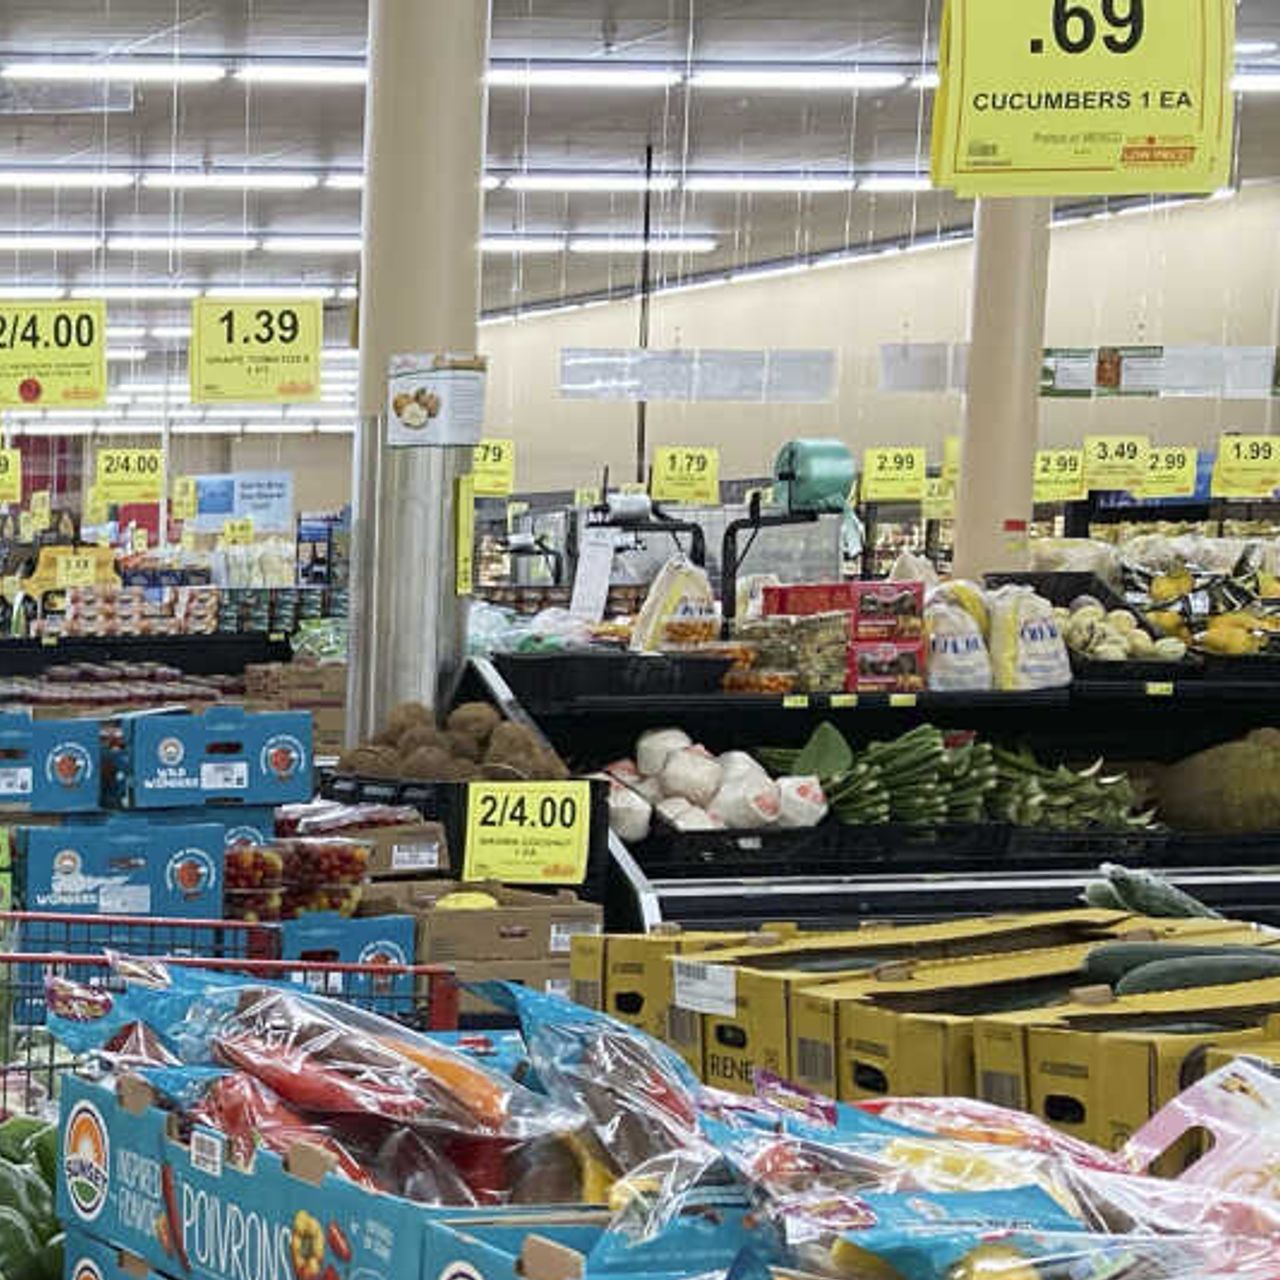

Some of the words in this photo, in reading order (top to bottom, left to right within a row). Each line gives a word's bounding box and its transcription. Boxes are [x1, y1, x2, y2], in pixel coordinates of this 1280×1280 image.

[1029, 0, 1145, 54] .69
[973, 91, 1132, 111] CUCUMBERS
[1140, 91, 1151, 109] 1
[1159, 90, 1193, 109] EA
[218, 309, 299, 344] 1.39
[1097, 442, 1138, 460] 3.49
[1233, 443, 1273, 460] 1.99
[104, 455, 159, 474] 2/4.00
[668, 454, 708, 472] 1.79
[877, 454, 915, 471] 2.99
[1040, 456, 1078, 473] 2.99
[1150, 453, 1186, 470] 2.99
[479, 795, 576, 829] 2/4.00
[708, 1052, 754, 1081] RENE
[66, 1156, 108, 1187] SUNSET
